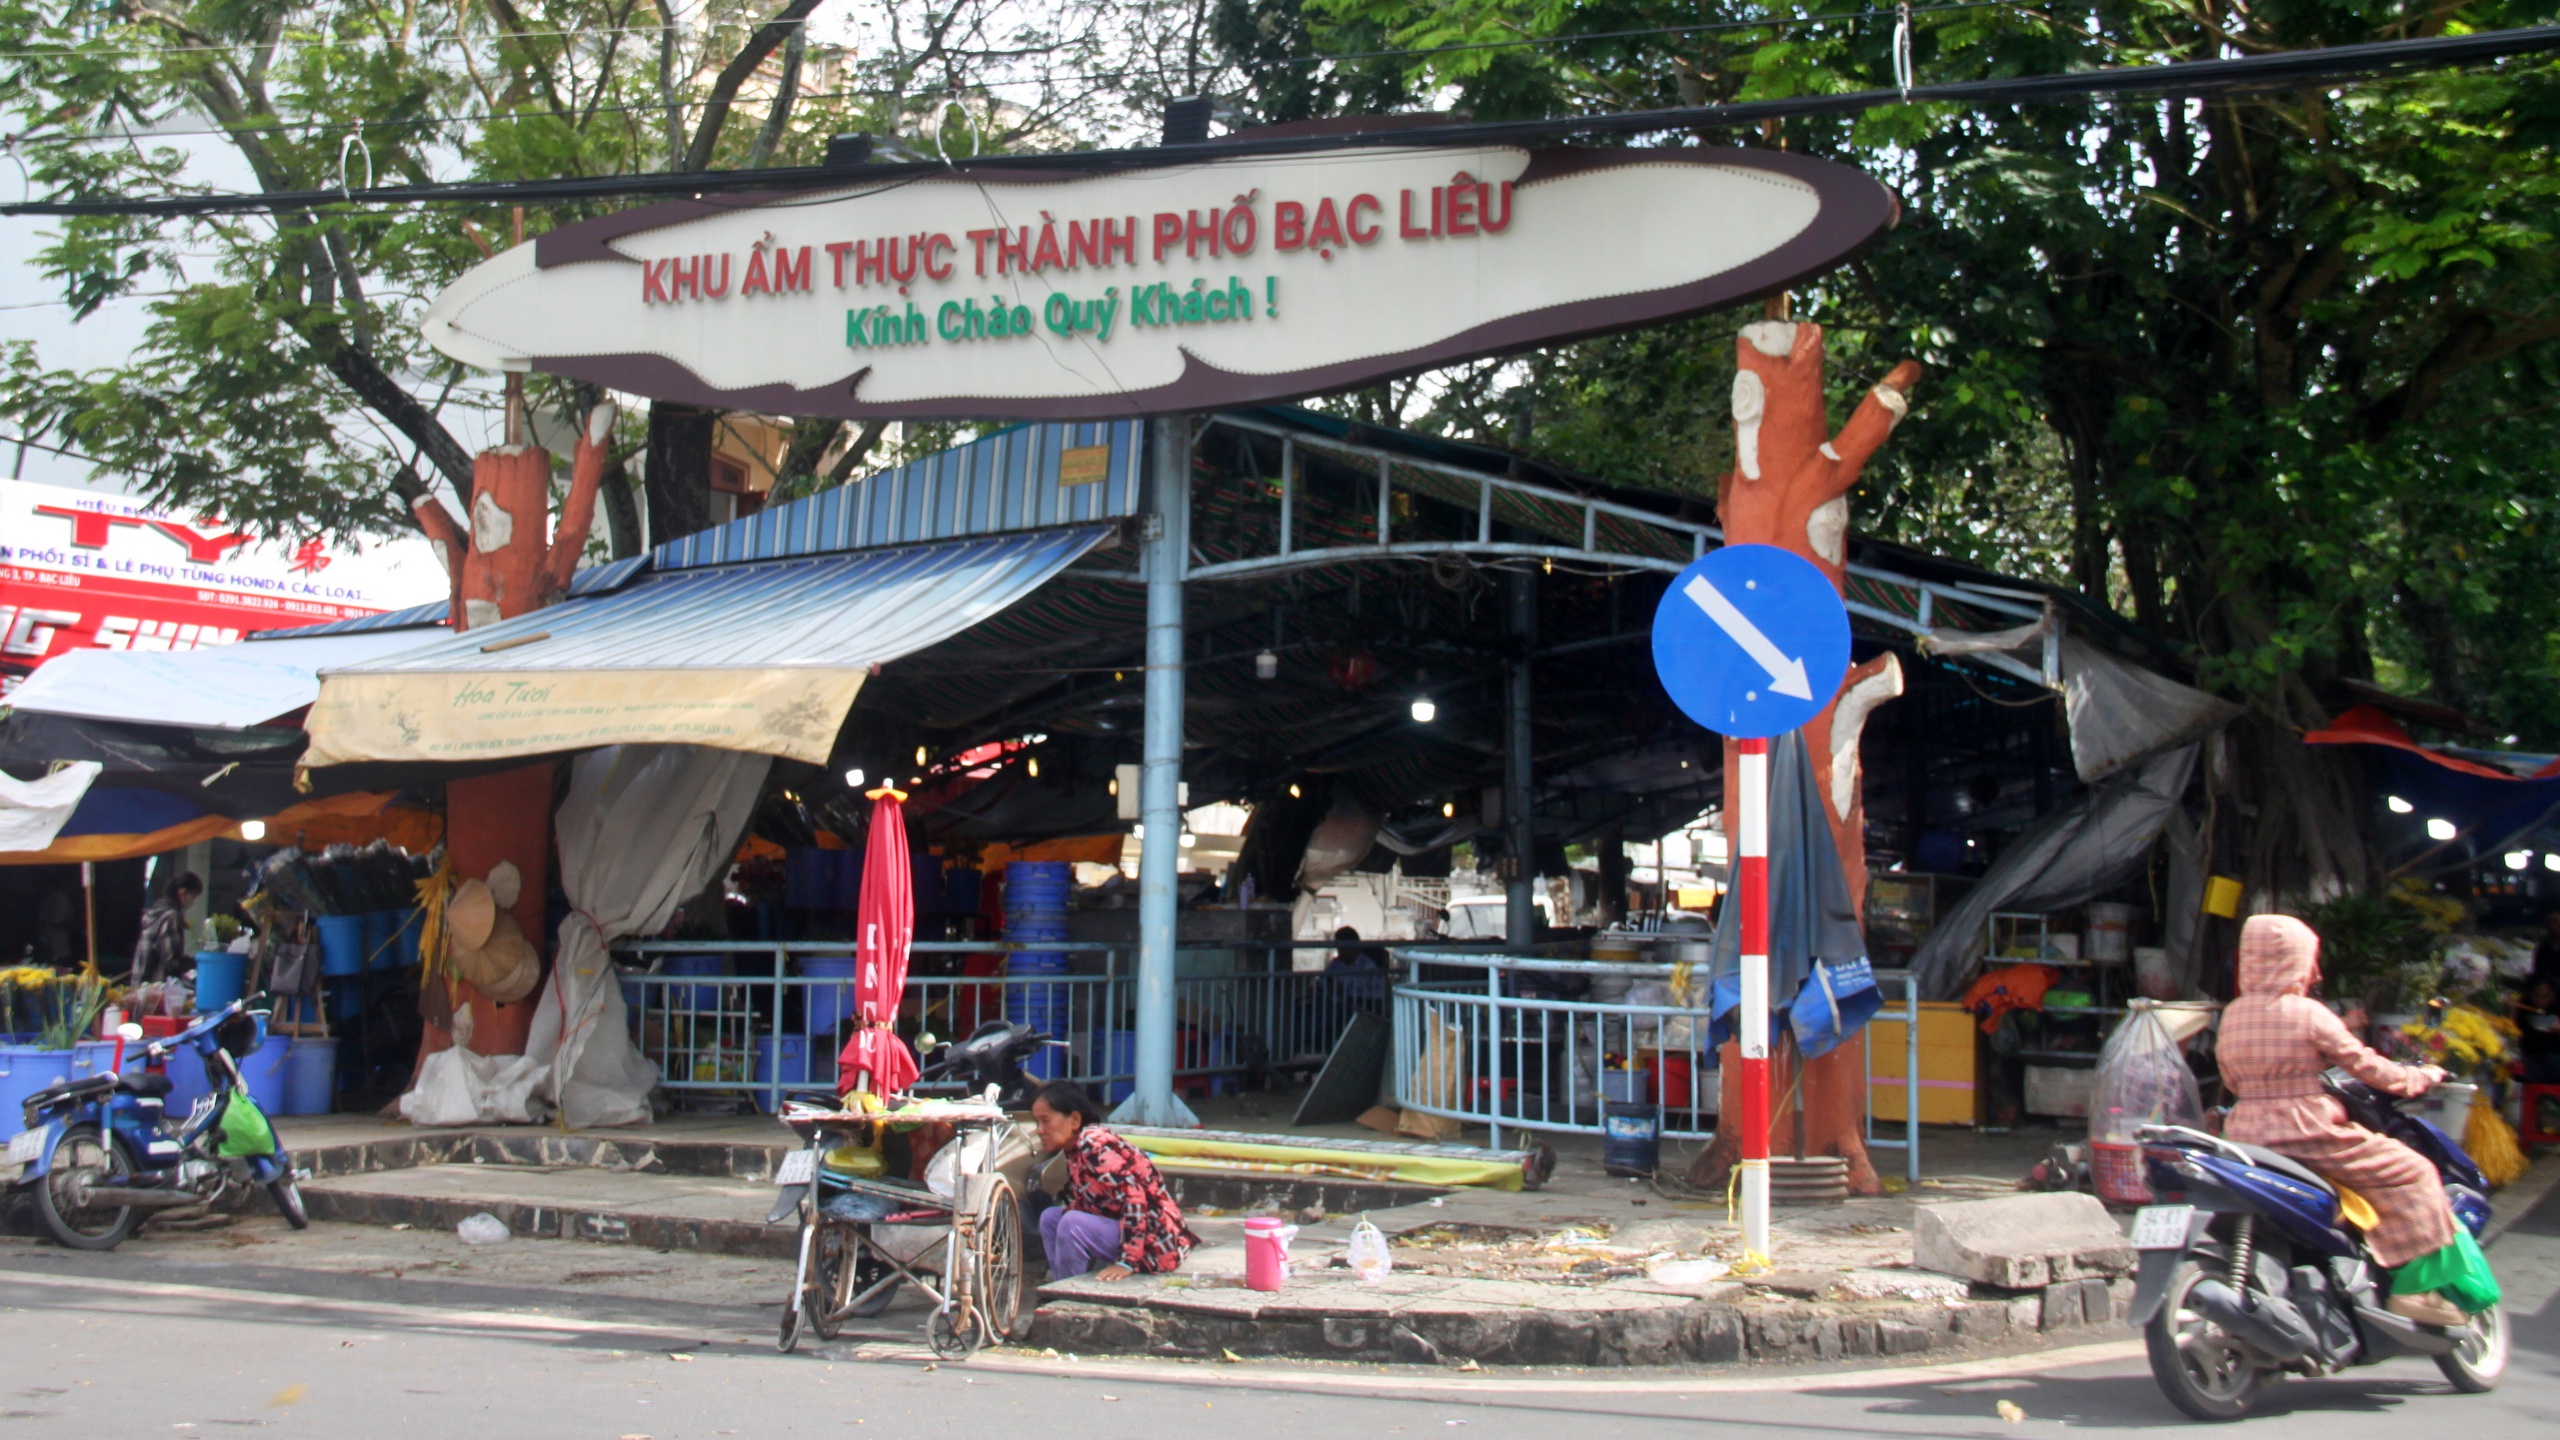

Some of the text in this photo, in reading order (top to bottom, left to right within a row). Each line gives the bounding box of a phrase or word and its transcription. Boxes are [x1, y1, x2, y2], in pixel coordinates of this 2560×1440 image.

[643, 171, 1513, 303] KHU ẨM THỰC THÀNH PHỐ BẠC LIÊU
[847, 276, 1278, 347] Kính Chào Quý Khách !
[19, 546, 65, 565] PHỐI
[96, 558, 108, 569] &
[140, 563, 176, 580] PHỤ
[183, 564, 225, 584] TÙNG
[231, 574, 286, 591] HONDA
[291, 578, 321, 595] CÁC
[453, 679, 495, 708] Hoa
